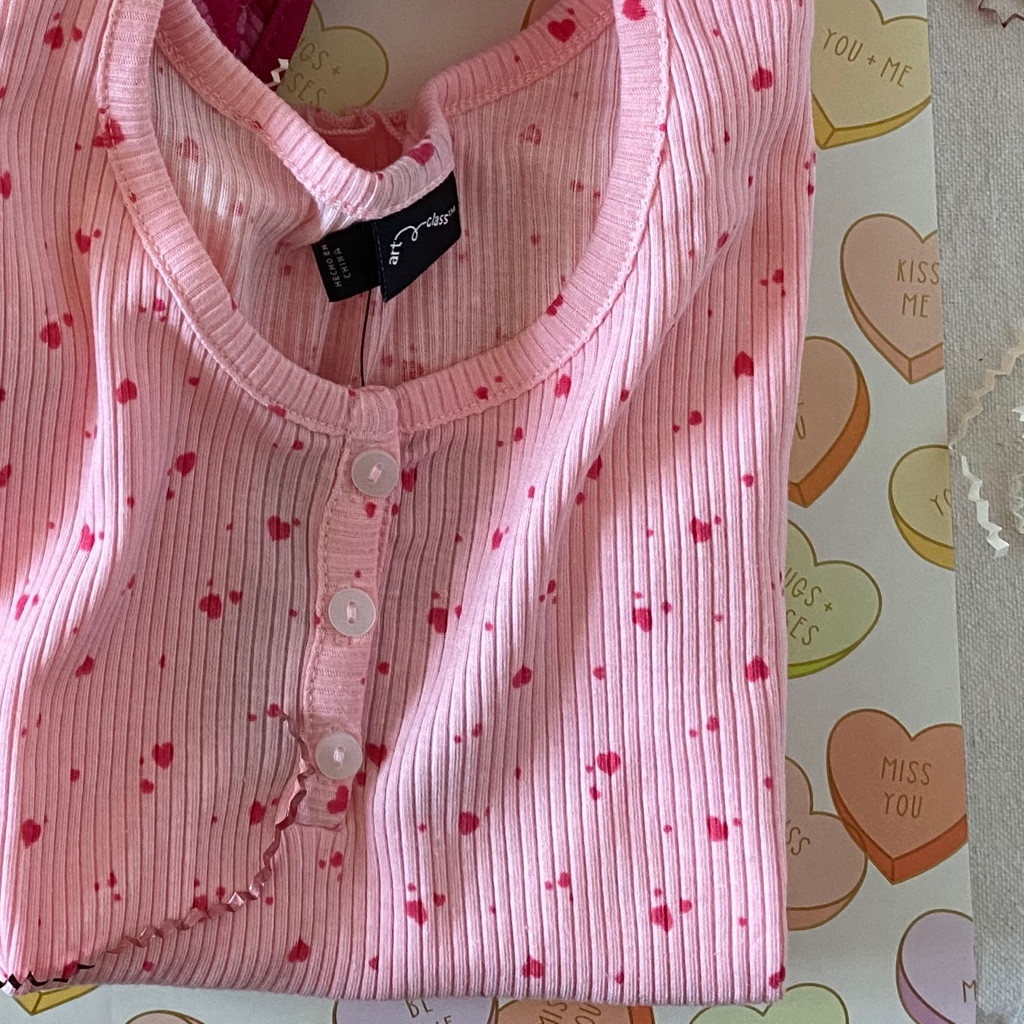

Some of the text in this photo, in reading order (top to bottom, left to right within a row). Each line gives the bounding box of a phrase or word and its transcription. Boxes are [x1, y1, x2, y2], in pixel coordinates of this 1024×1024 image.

[822, 28, 863, 62] YOU
[880, 58, 913, 88] ME
[334, 247, 352, 279] CHINA
[388, 241, 403, 266] art
[902, 293, 929, 318] ME
[881, 756, 933, 786] MISS
[884, 792, 923, 819] YOU
